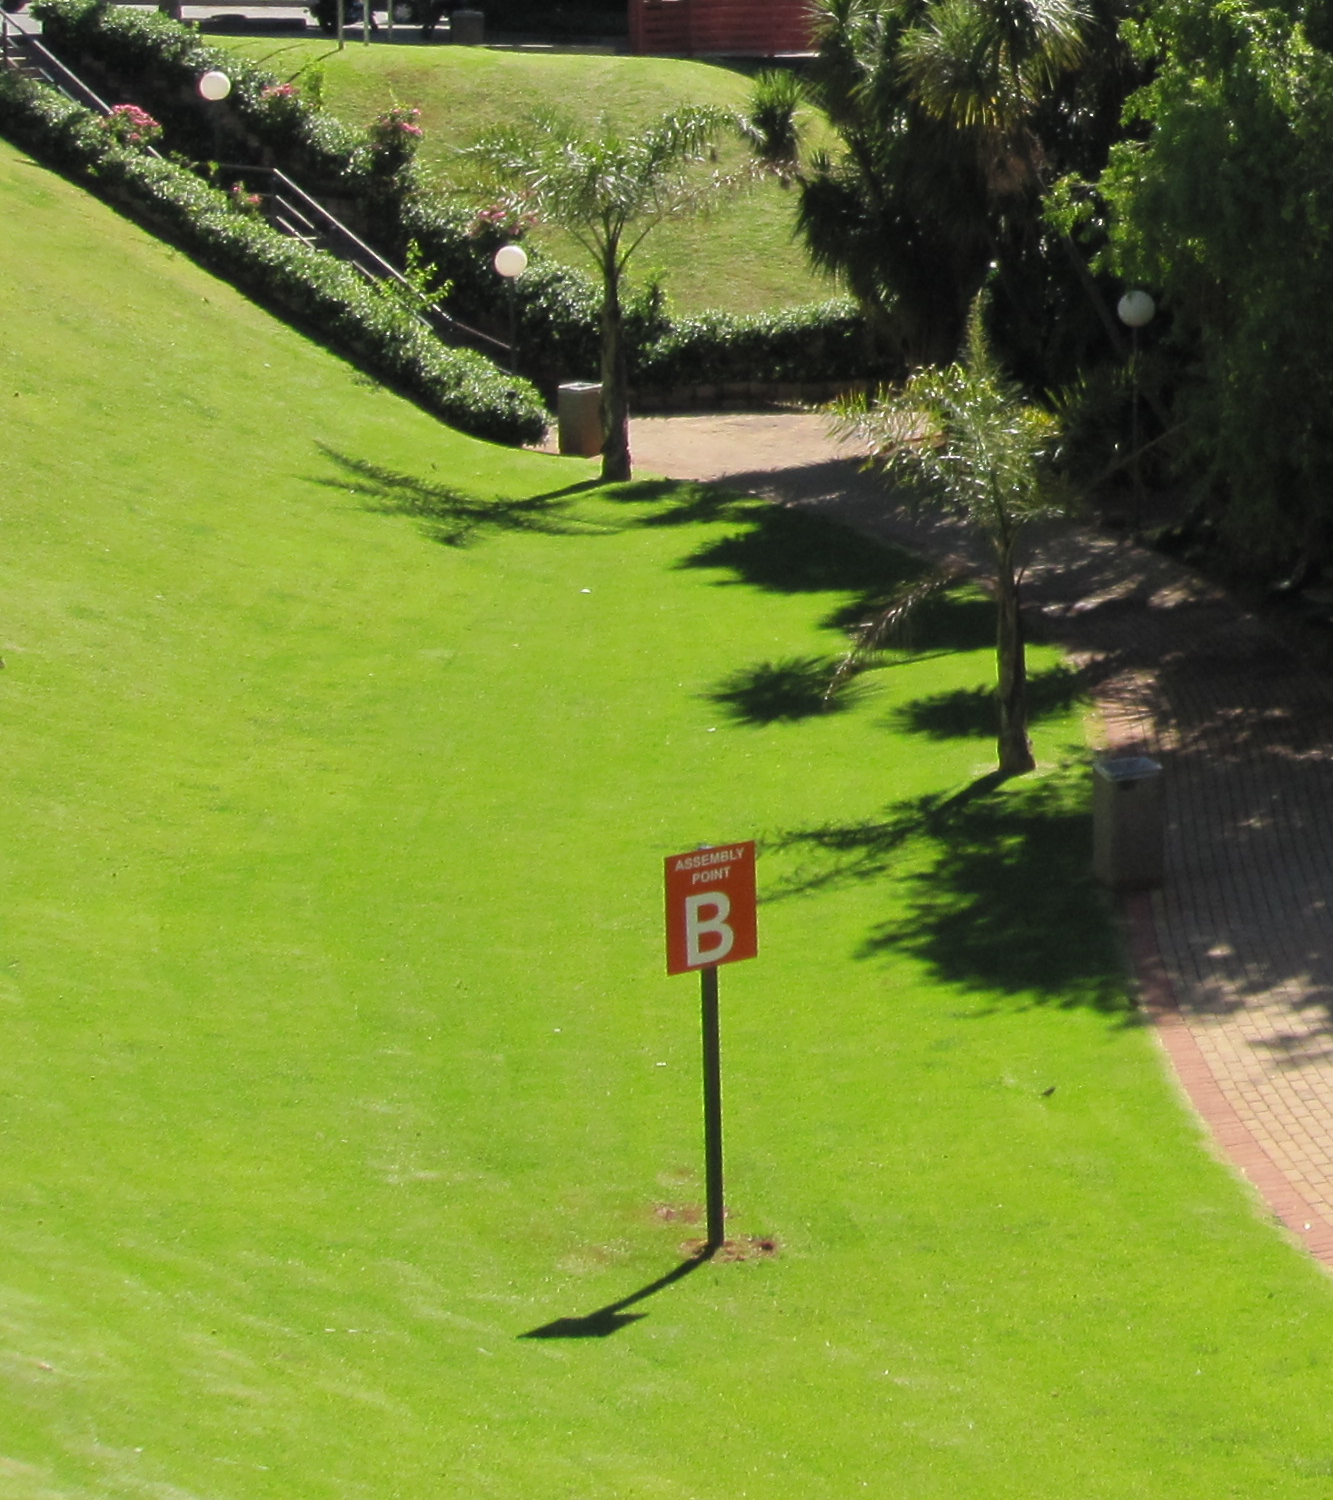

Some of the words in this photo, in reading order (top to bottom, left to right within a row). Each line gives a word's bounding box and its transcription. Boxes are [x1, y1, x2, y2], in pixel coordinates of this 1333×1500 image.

[675, 847, 744, 871] ASSEMBLY
[692, 866, 731, 885] POINT
[685, 891, 735, 968] B
